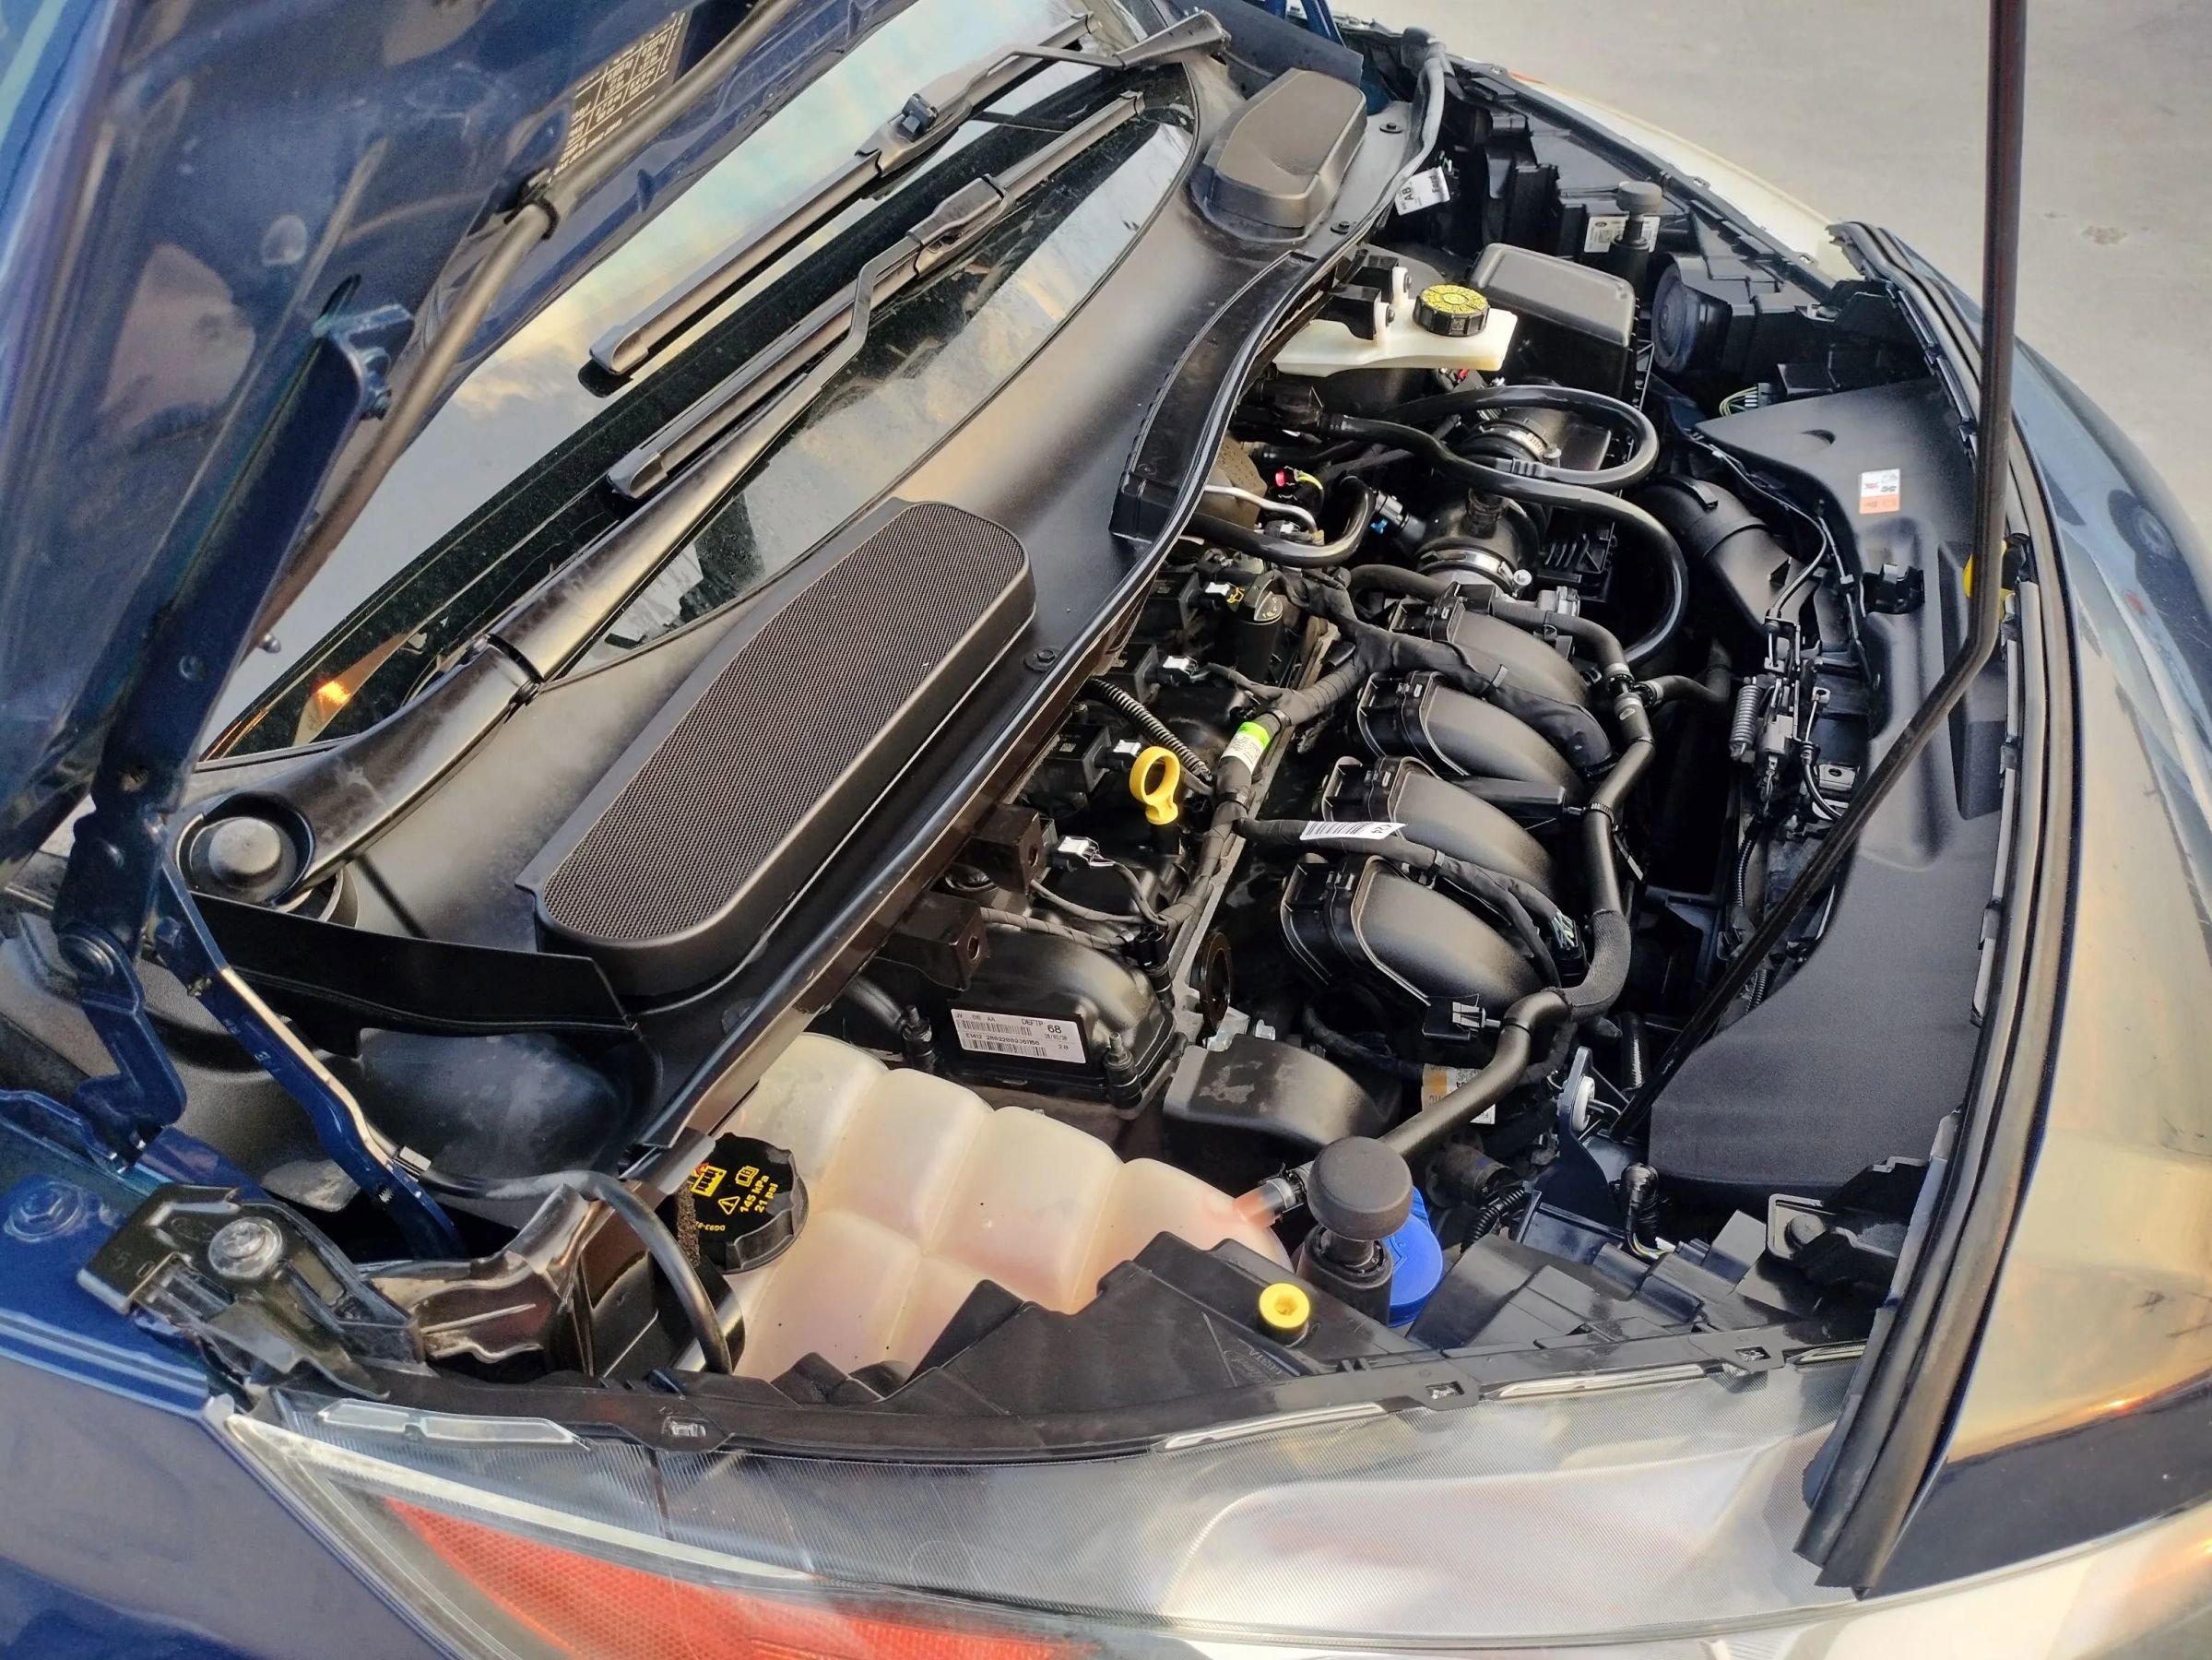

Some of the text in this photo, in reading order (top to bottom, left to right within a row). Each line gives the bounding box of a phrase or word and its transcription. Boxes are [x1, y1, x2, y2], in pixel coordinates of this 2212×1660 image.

[1402, 186, 1414, 200] AB
[1428, 175, 1440, 193] Ford
[1047, 1025, 1062, 1034] 68
[739, 1175, 769, 1213] 145 kPa
[754, 1182, 778, 1213] 21 psi
